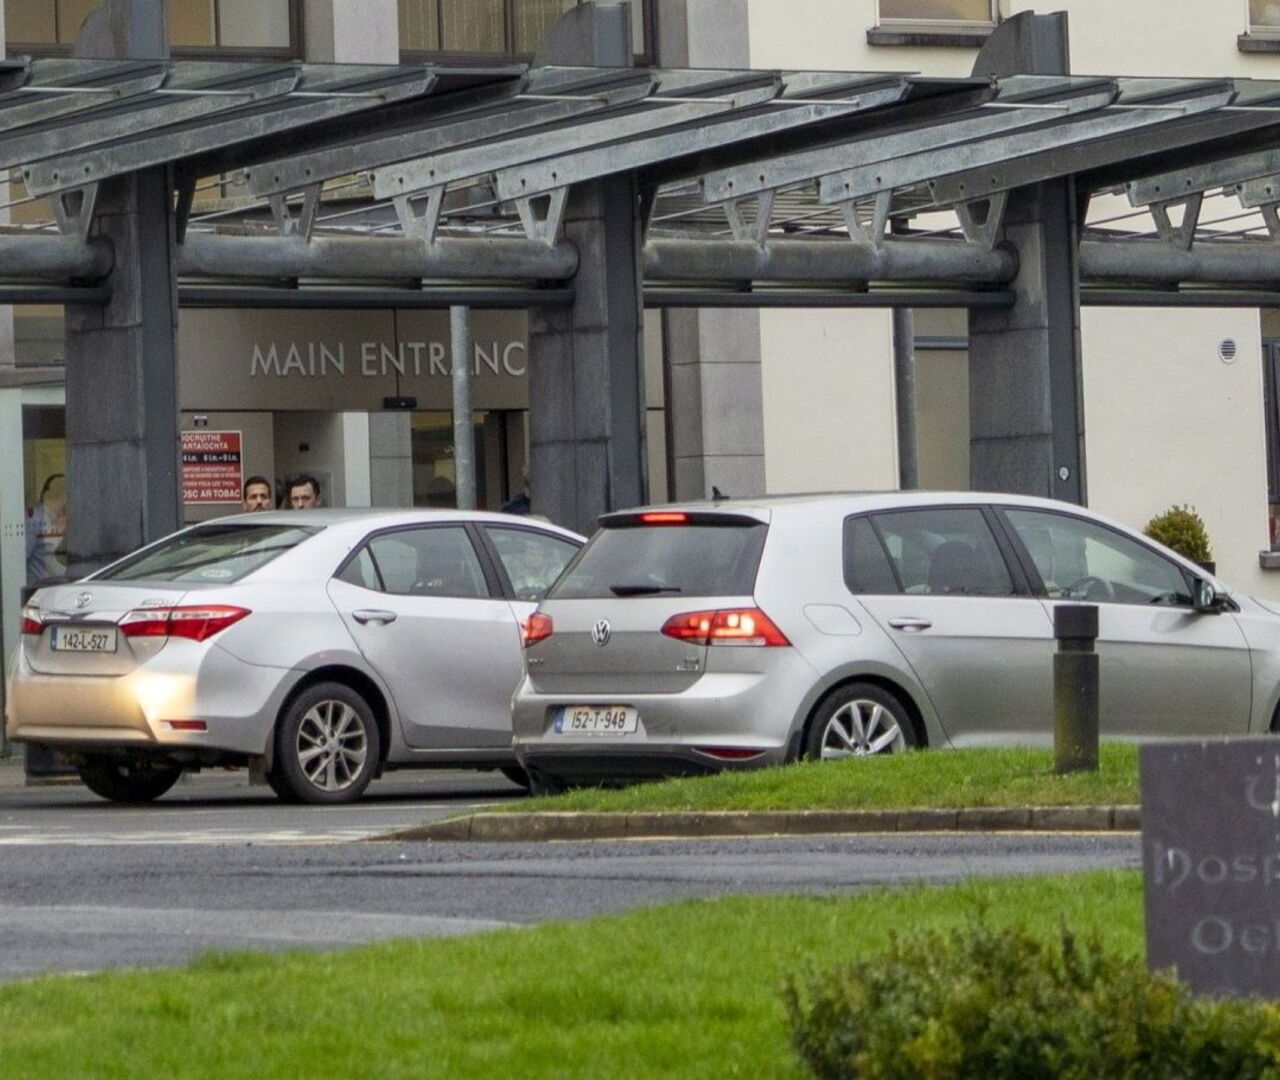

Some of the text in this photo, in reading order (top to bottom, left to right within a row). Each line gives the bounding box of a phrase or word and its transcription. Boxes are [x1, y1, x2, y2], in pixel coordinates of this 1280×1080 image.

[250, 342, 526, 376] MAIN ENTRNC
[213, 489, 240, 498] TOBAC
[62, 633, 109, 652] 142-L-527
[571, 711, 627, 730] 152-T-948
